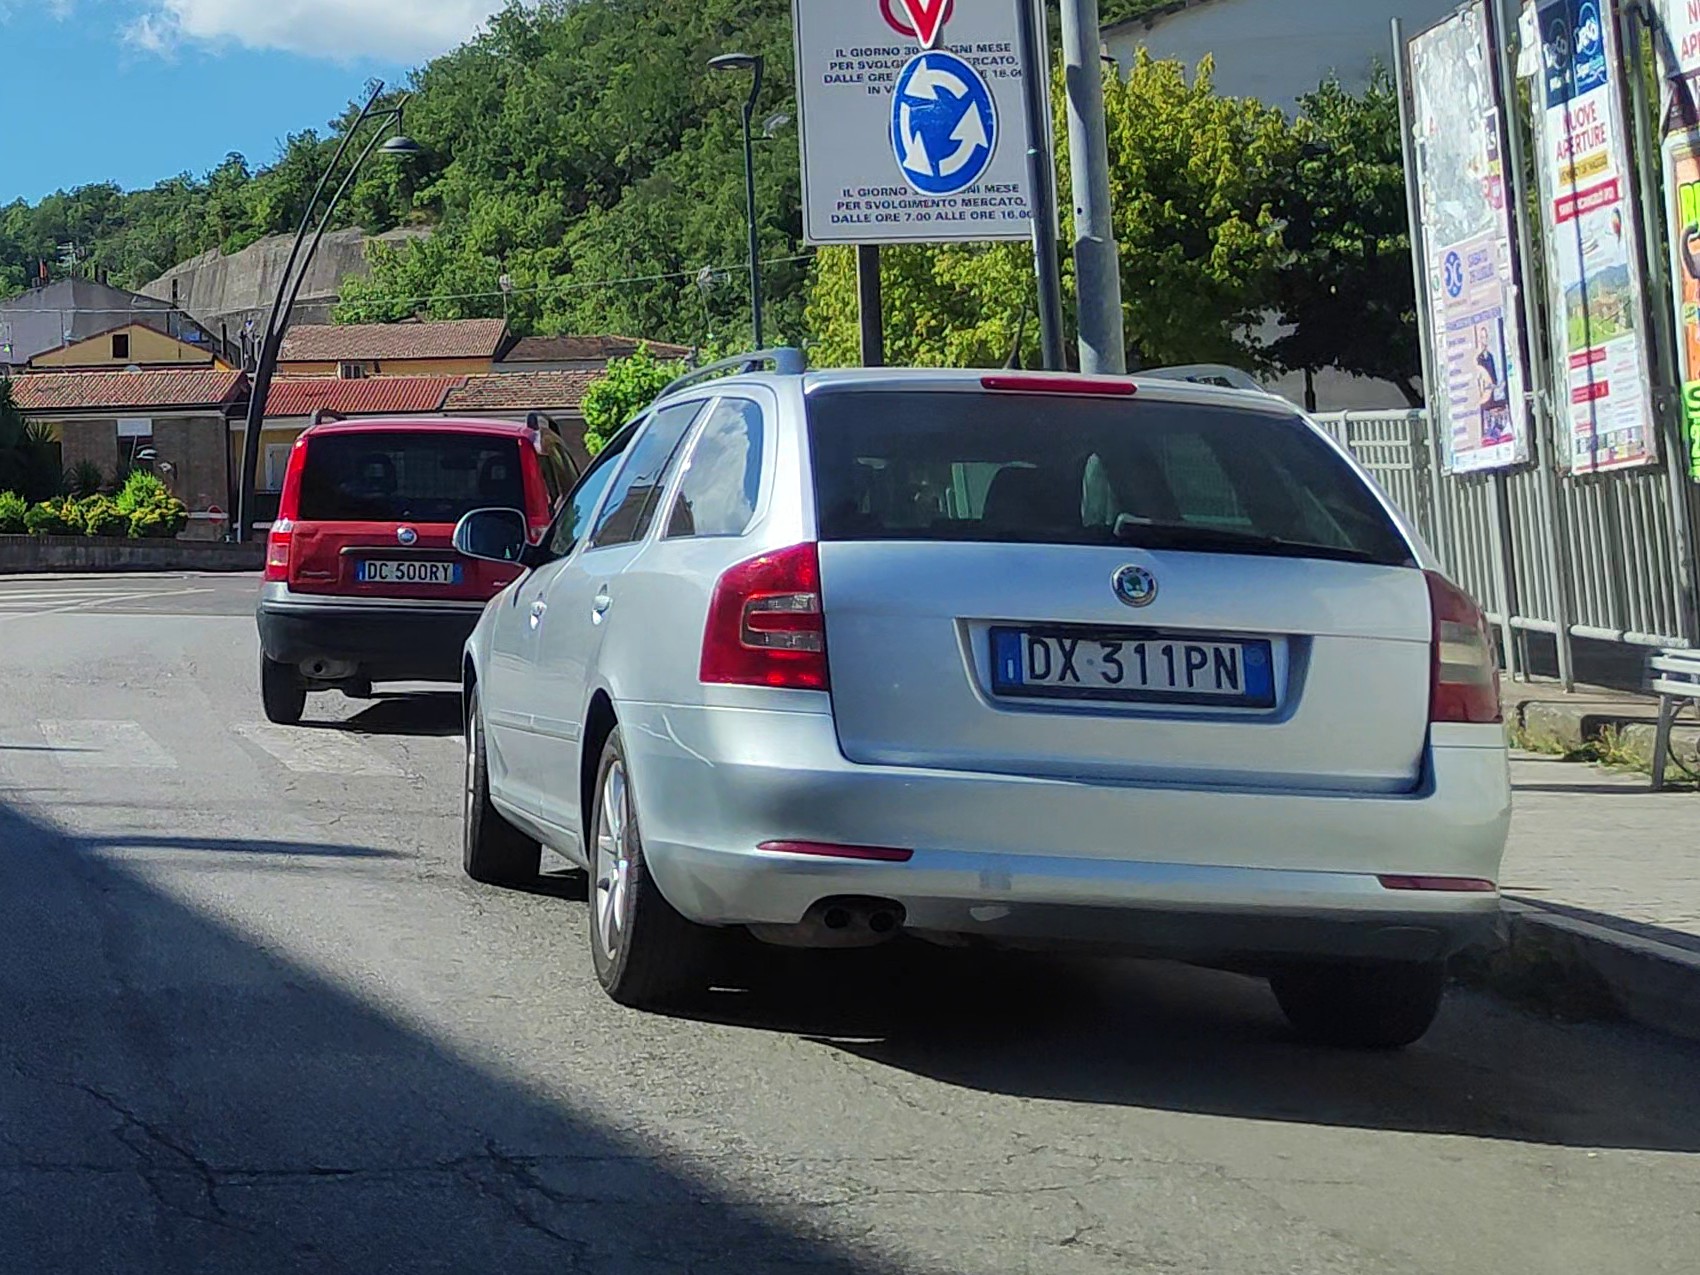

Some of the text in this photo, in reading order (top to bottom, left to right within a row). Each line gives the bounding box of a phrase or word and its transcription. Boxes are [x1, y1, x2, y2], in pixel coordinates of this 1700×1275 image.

[835, 48, 847, 58] IL
[850, 47, 901, 58] GIORNO
[976, 42, 1012, 53] MESE
[829, 61, 855, 71] PER
[823, 73, 864, 84] DALLE
[867, 72, 894, 82] ORE
[867, 85, 881, 95] IN
[1563, 100, 1598, 135] NUOVE
[1556, 122, 1607, 162] APERTURE
[842, 188, 854, 198] IL
[857, 186, 908, 197] GIORNO
[984, 183, 1019, 194] MESE
[836, 200, 862, 211] PER
[864, 198, 957, 210] SVOLGIMENTO
[831, 213, 872, 224] DALLE
[875, 212, 901, 223] ORE
[904, 211, 931, 223] 7.00
[935, 210, 966, 221] ALLE
[969, 210, 996, 220] ORE
[367, 562, 389, 580] DC
[395, 563, 451, 582] 500RY
[1027, 638, 1081, 683] DX
[1100, 642, 1239, 690] 311PN
